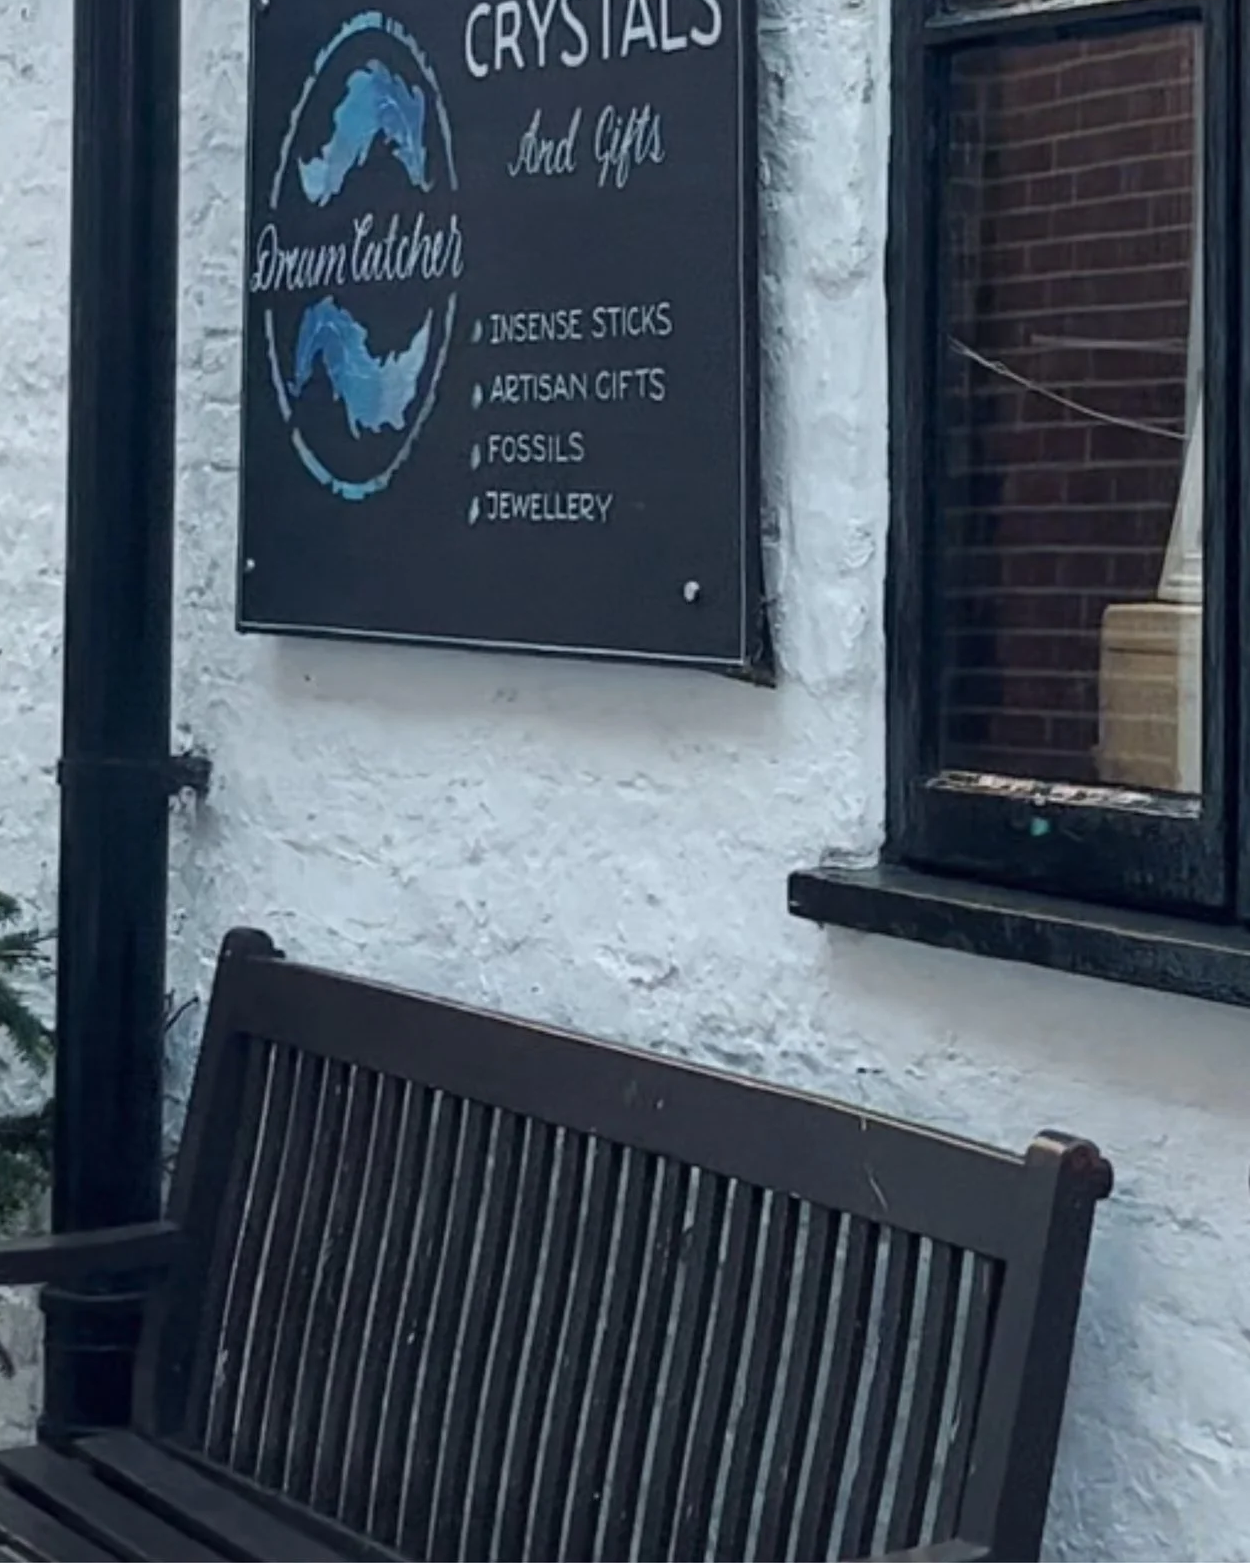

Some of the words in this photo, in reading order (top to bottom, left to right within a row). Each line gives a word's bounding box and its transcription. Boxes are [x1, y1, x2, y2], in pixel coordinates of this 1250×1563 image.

[507, 108, 582, 177] And
[594, 103, 665, 189] Gifts
[250, 223, 347, 293] Dream
[351, 211, 464, 283] Catcher
[489, 309, 583, 345] INSENSE
[591, 302, 674, 338] STICKS
[489, 372, 588, 404] ARTISAN
[488, 431, 586, 464] FOSSILS
[485, 491, 614, 524] JEWELLERY
